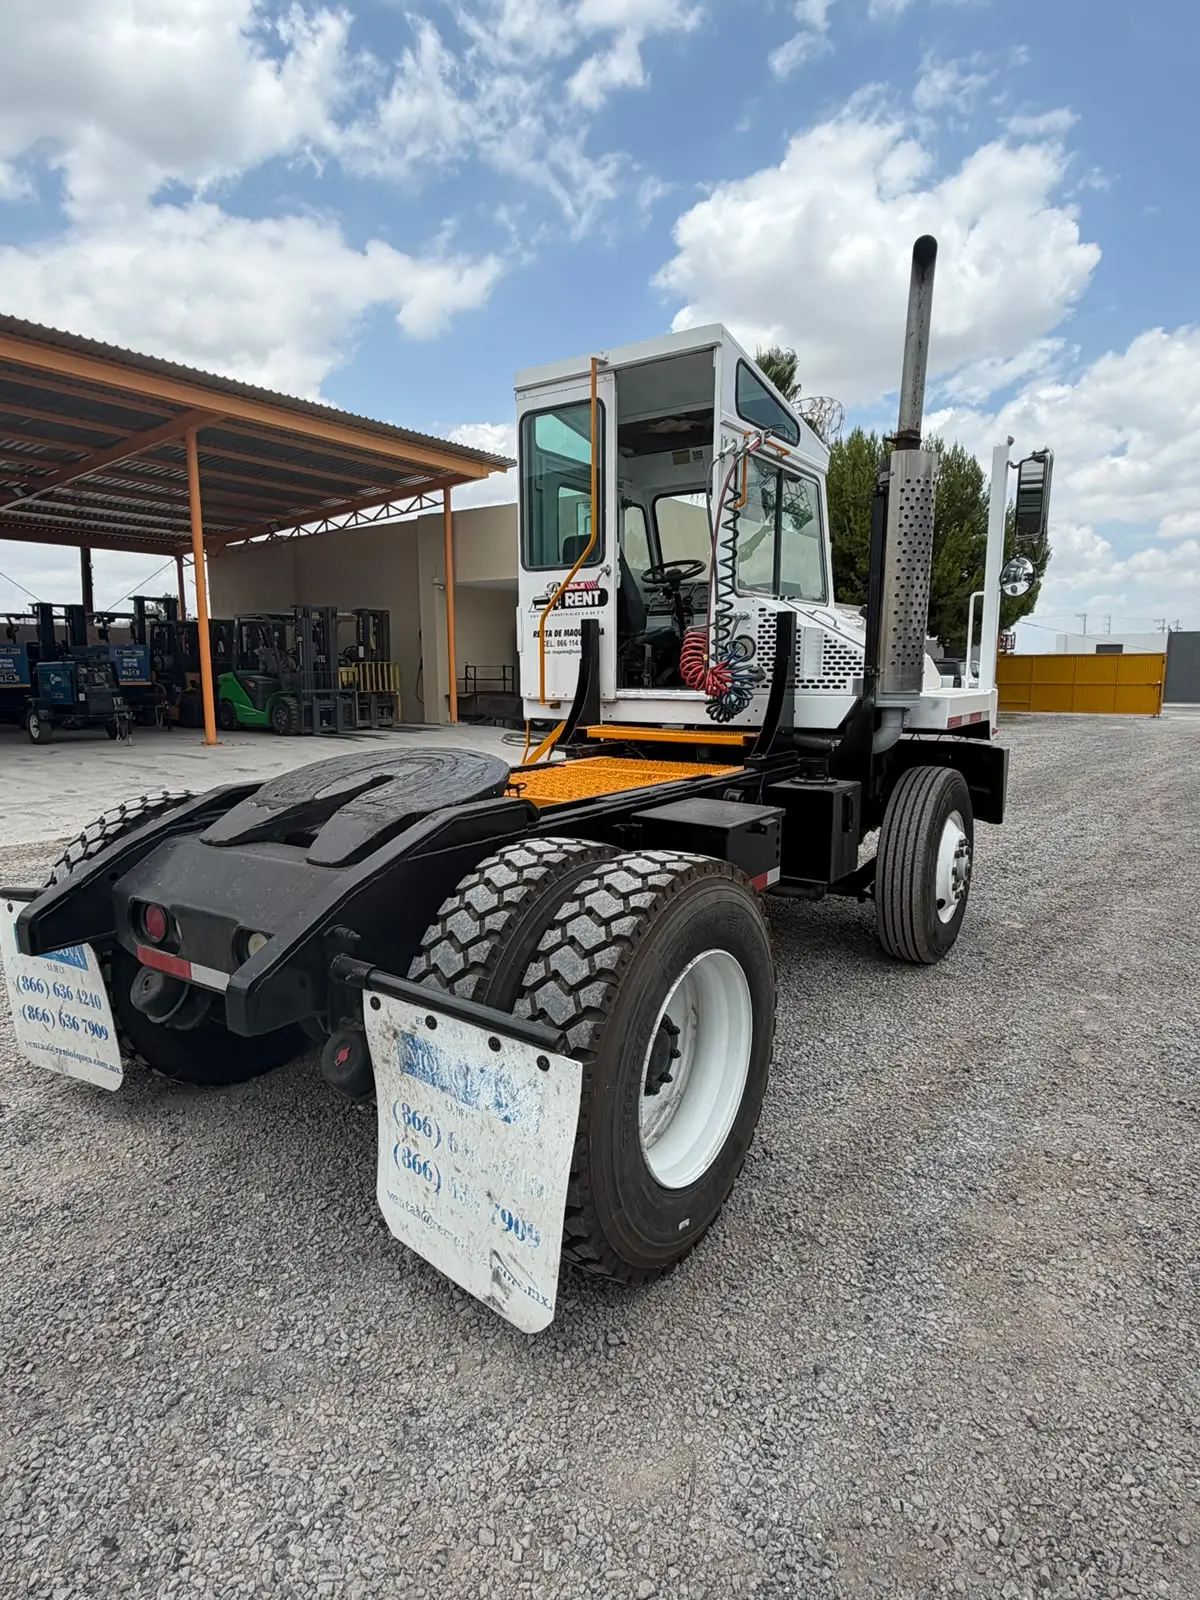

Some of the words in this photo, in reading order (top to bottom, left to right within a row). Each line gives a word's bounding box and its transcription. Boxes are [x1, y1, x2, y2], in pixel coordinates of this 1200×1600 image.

[565, 591, 601, 607] RENT
[533, 630, 553, 638] RETA
[554, 629, 562, 637] DE
[16, 974, 50, 1000] (866)
[53, 981, 74, 1001] 636
[76, 988, 102, 1011] 4240
[22, 1004, 56, 1029] (866)
[58, 1009, 80, 1032] 636
[81, 1019, 109, 1041] 7909
[392, 1099, 442, 1149] (866)
[393, 1141, 442, 1195] (866)
